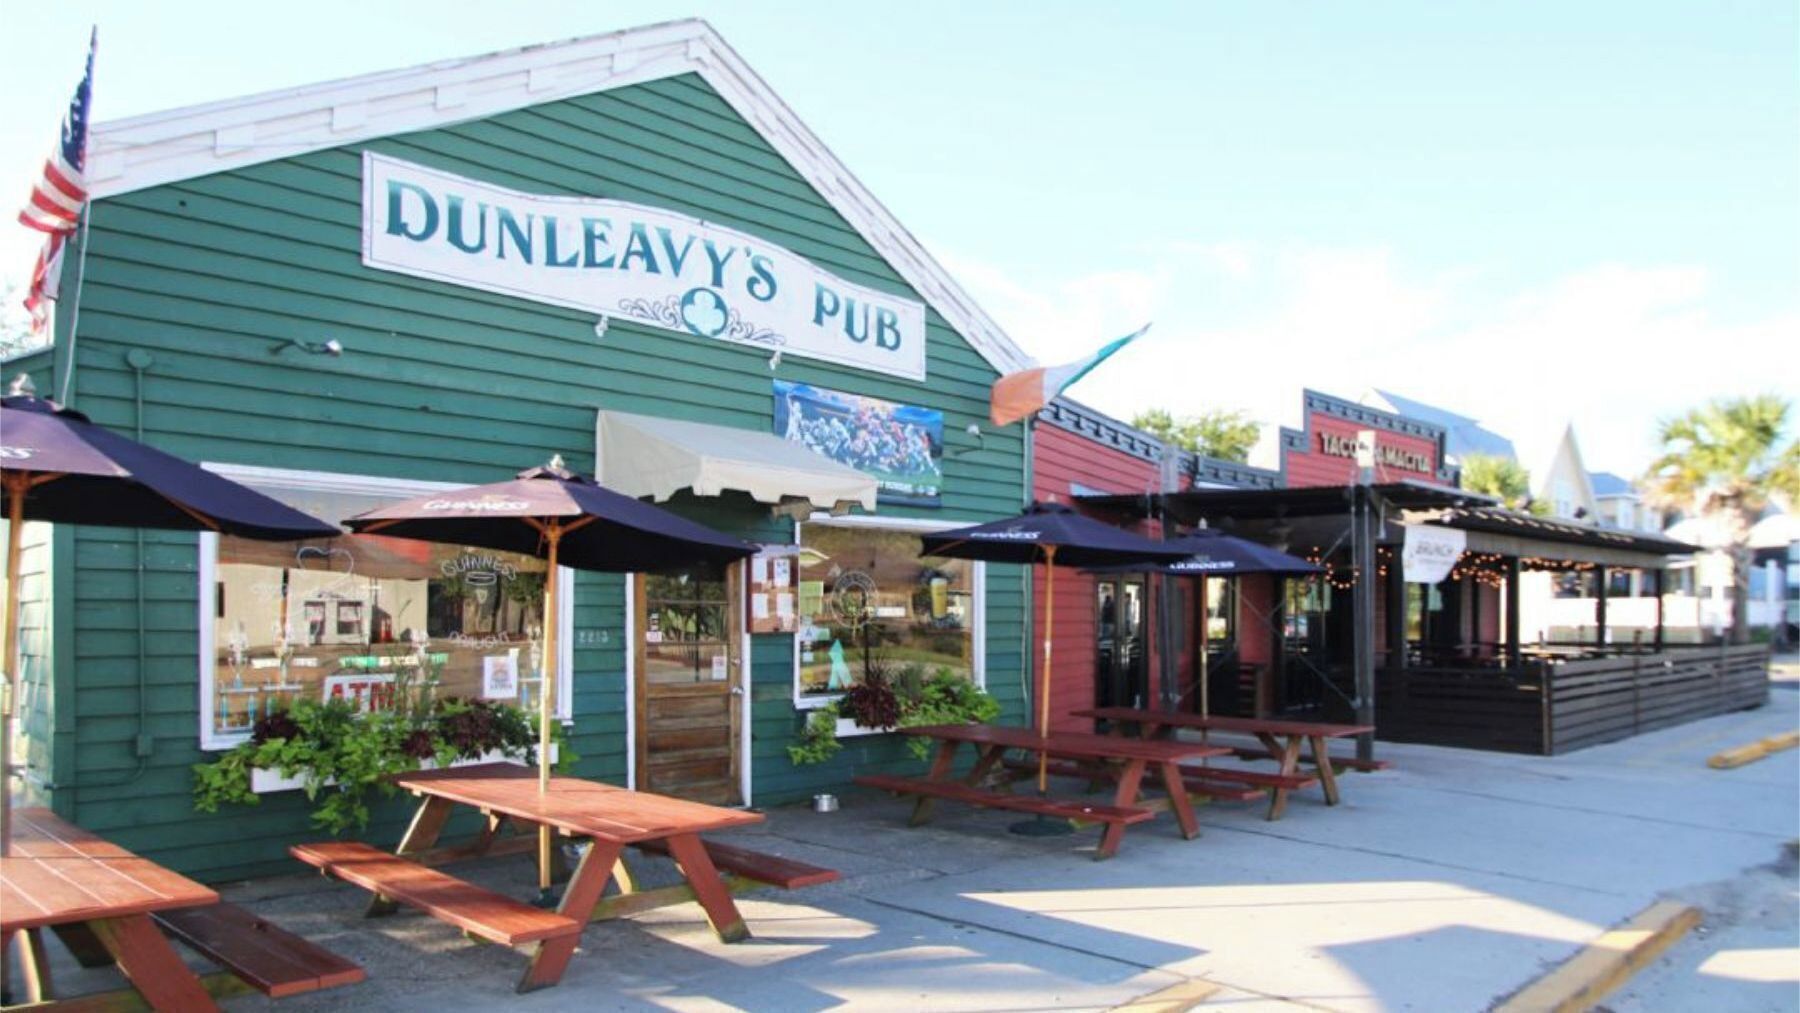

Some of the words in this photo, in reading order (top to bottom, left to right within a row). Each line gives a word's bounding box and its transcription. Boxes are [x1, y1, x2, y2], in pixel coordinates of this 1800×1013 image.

[386, 179, 777, 302] DUNLEAVY'S
[813, 282, 902, 352] PUB
[1319, 431, 1360, 459] TACO
[422, 499, 530, 511] GUINNESS
[970, 531, 1042, 540] GUINNESS
[1168, 560, 1236, 570] GUINNESS
